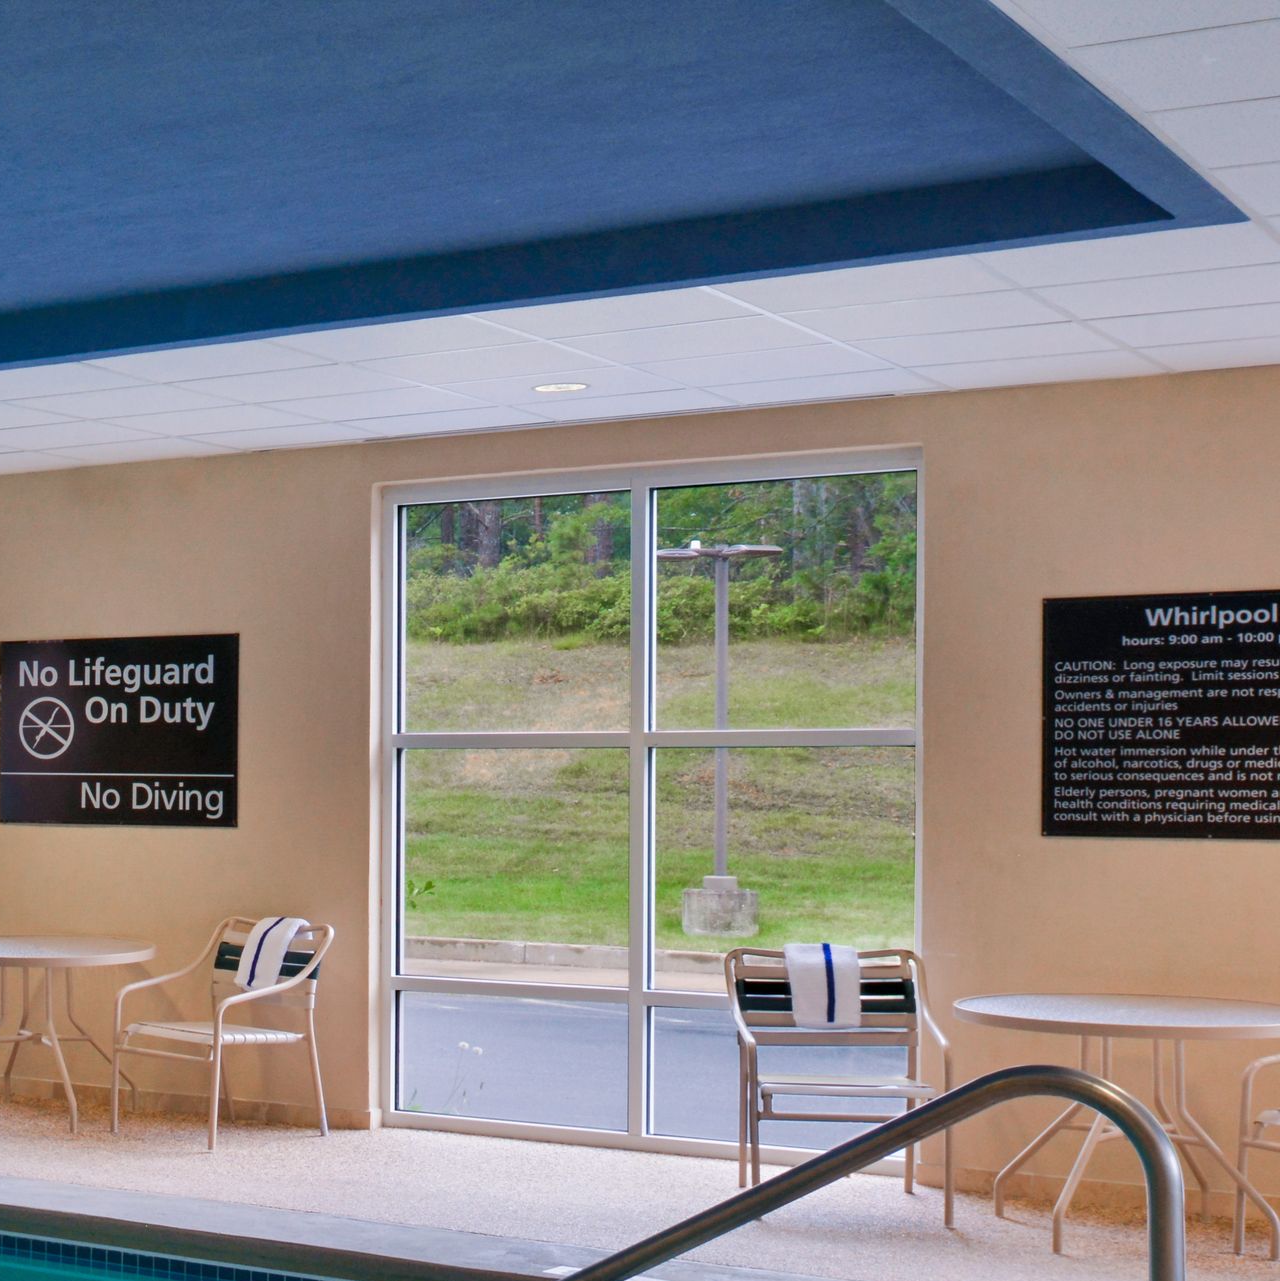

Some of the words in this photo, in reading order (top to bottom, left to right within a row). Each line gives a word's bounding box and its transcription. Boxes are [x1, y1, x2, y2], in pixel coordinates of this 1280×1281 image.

[1145, 603, 1278, 629] Whirlpool
[1122, 636, 1164, 646] hours:
[1169, 635, 1197, 645] 9:00
[1237, 633, 1274, 643] 10:00
[1055, 661, 1116, 672] CAUTION:
[1124, 661, 1155, 671] Long
[1159, 660, 1217, 671] exposure
[1222, 659, 1248, 669] may
[19, 660, 58, 687] No
[69, 655, 214, 693] Lifeguard
[1055, 674, 1108, 684] dizziness
[1130, 672, 1184, 684] fainting.
[1192, 671, 1224, 681] Limit
[1228, 670, 1279, 680] sessions
[1055, 690, 1101, 700] Owners
[1106, 689, 1114, 699] &
[1118, 688, 1203, 701] management
[1207, 688, 1228, 698] are
[1232, 687, 1254, 697] not
[1055, 702, 1110, 712] accidents
[1115, 703, 1128, 711] or
[1132, 700, 1178, 713] injuries
[85, 697, 127, 723] On
[140, 696, 215, 731] Duty
[1055, 718, 1074, 728] NO
[1078, 718, 1104, 727] ONE
[1109, 717, 1153, 727] UNDER
[1158, 717, 1172, 727] 16
[1176, 716, 1218, 726] YEARS
[1055, 730, 1074, 740] DO
[1078, 730, 1105, 740] NOT
[1109, 730, 1132, 739] USE
[1136, 729, 1180, 739] ALONE
[1055, 747, 1076, 756] Hot
[1080, 748, 1116, 756] water
[1121, 746, 1186, 756] immersion
[1191, 746, 1226, 756] while
[1230, 746, 1269, 756] under
[1055, 759, 1067, 769] of
[1071, 759, 1119, 770] alcohol,
[1123, 759, 1181, 770] narcotics,
[1186, 758, 1223, 771] drugs
[1227, 760, 1241, 768] or
[1054, 772, 1067, 780] to
[1071, 771, 1114, 781] serious
[1117, 772, 1204, 782] consequences
[1208, 770, 1232, 781] and
[1237, 771, 1246, 781] is
[1250, 771, 1273, 781] not
[1054, 787, 1095, 799] Elderly
[1100, 789, 1150, 799] persons,
[1154, 788, 1214, 799] pregnant
[81, 782, 120, 810] No
[132, 782, 224, 819] Diving
[1054, 799, 1092, 809] health
[1097, 799, 1162, 809] conditions
[1166, 799, 1225, 812] requiring
[1230, 800, 1280, 810] medical
[1054, 812, 1097, 821] consult
[1102, 812, 1129, 821] with
[1145, 812, 1203, 824] physician
[1207, 812, 1251, 823] before
